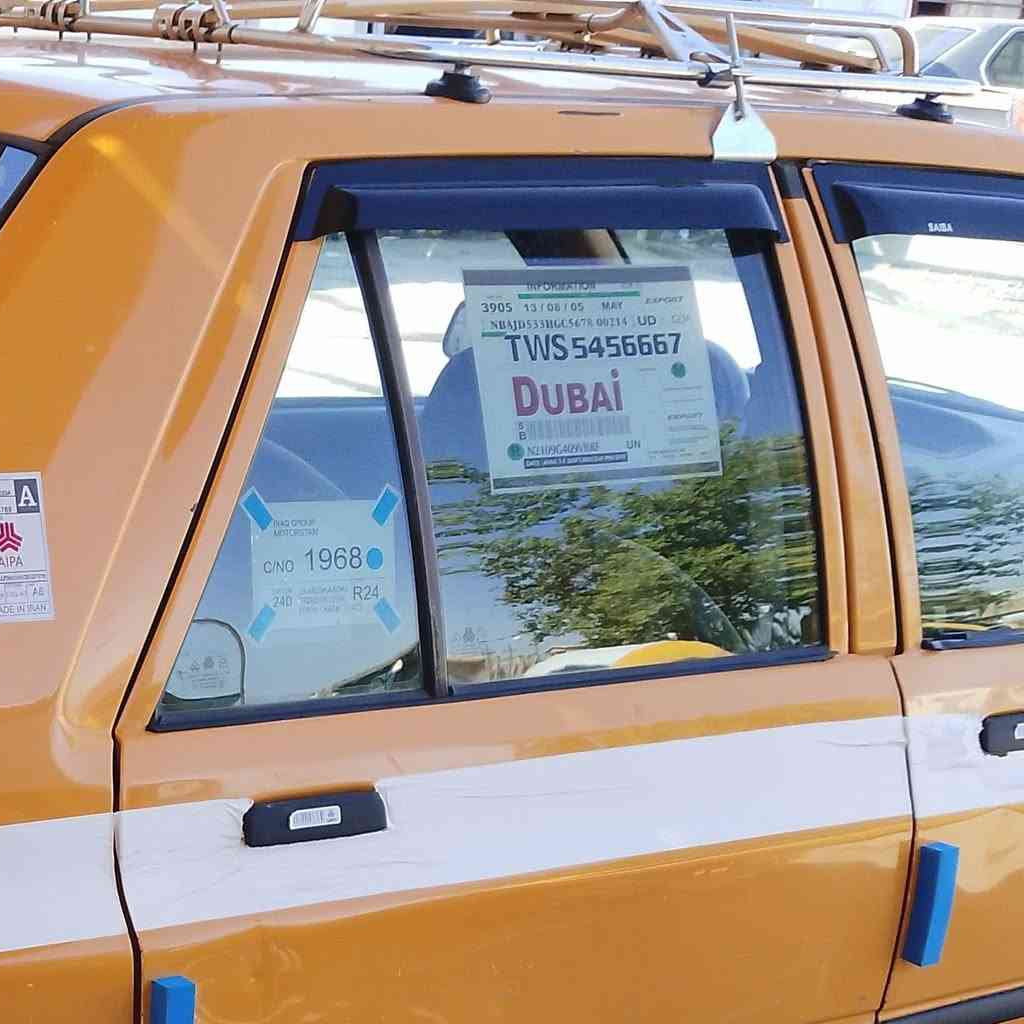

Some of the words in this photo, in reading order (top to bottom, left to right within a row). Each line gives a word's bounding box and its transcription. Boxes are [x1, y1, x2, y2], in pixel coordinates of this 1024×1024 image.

[481, 302, 513, 313] 3905
[602, 301, 624, 312] MAY
[637, 315, 657, 326] UD
[626, 439, 641, 450] UN
[18, 485, 38, 507] A
[263, 559, 295, 574] C/NO
[304, 545, 362, 572] 1968
[352, 585, 380, 601] R24
[16, 603, 25, 613] IN
[26, 601, 47, 612] IRAN
